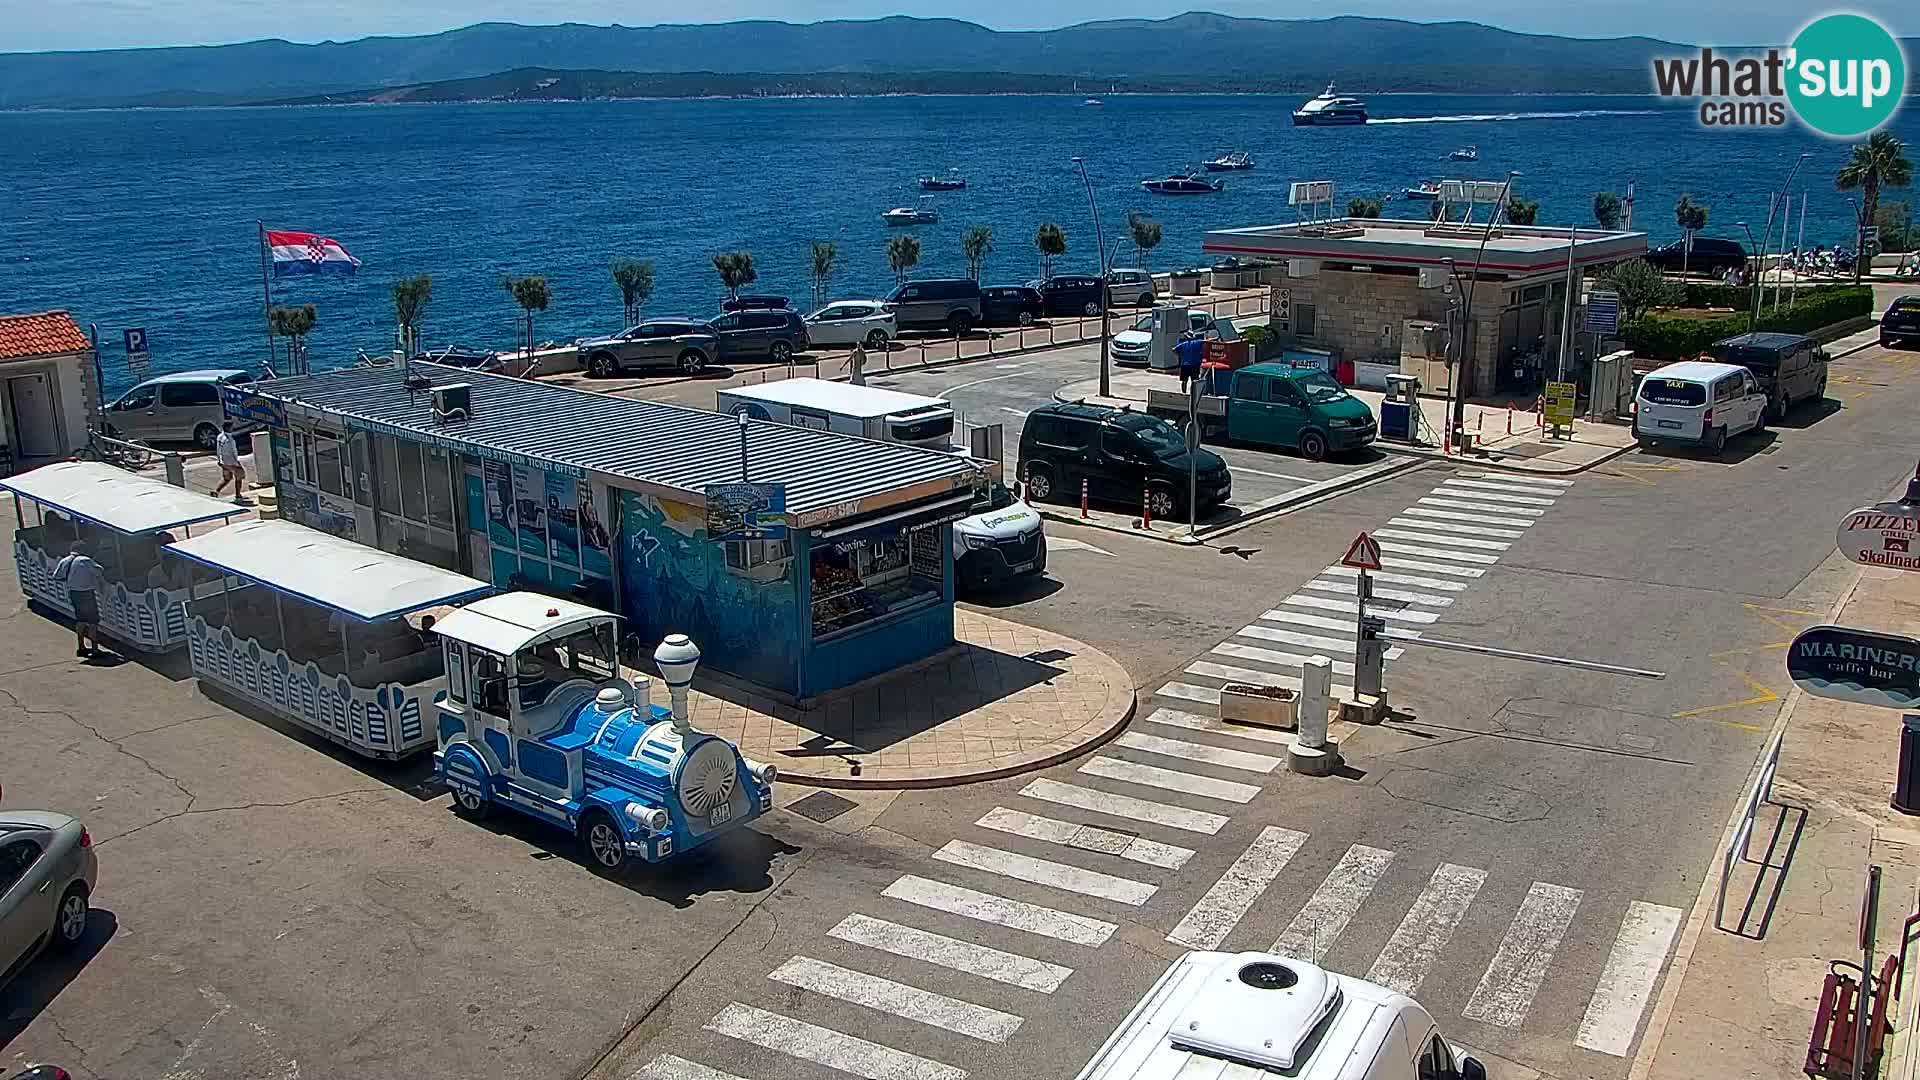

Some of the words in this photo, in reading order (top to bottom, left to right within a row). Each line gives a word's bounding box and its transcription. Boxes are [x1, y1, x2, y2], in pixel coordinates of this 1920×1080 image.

[128, 331, 141, 349] P
[1666, 380, 1685, 389] TAXI
[477, 445, 493, 457] BUS
[493, 449, 526, 465] STATION
[528, 457, 553, 471] TICKET
[554, 463, 582, 477] OFFICE
[1881, 530, 1916, 540] GRILL
[835, 538, 868, 553] Novine
[1828, 661, 1864, 673] caffe
[1870, 665, 1896, 680] bar
